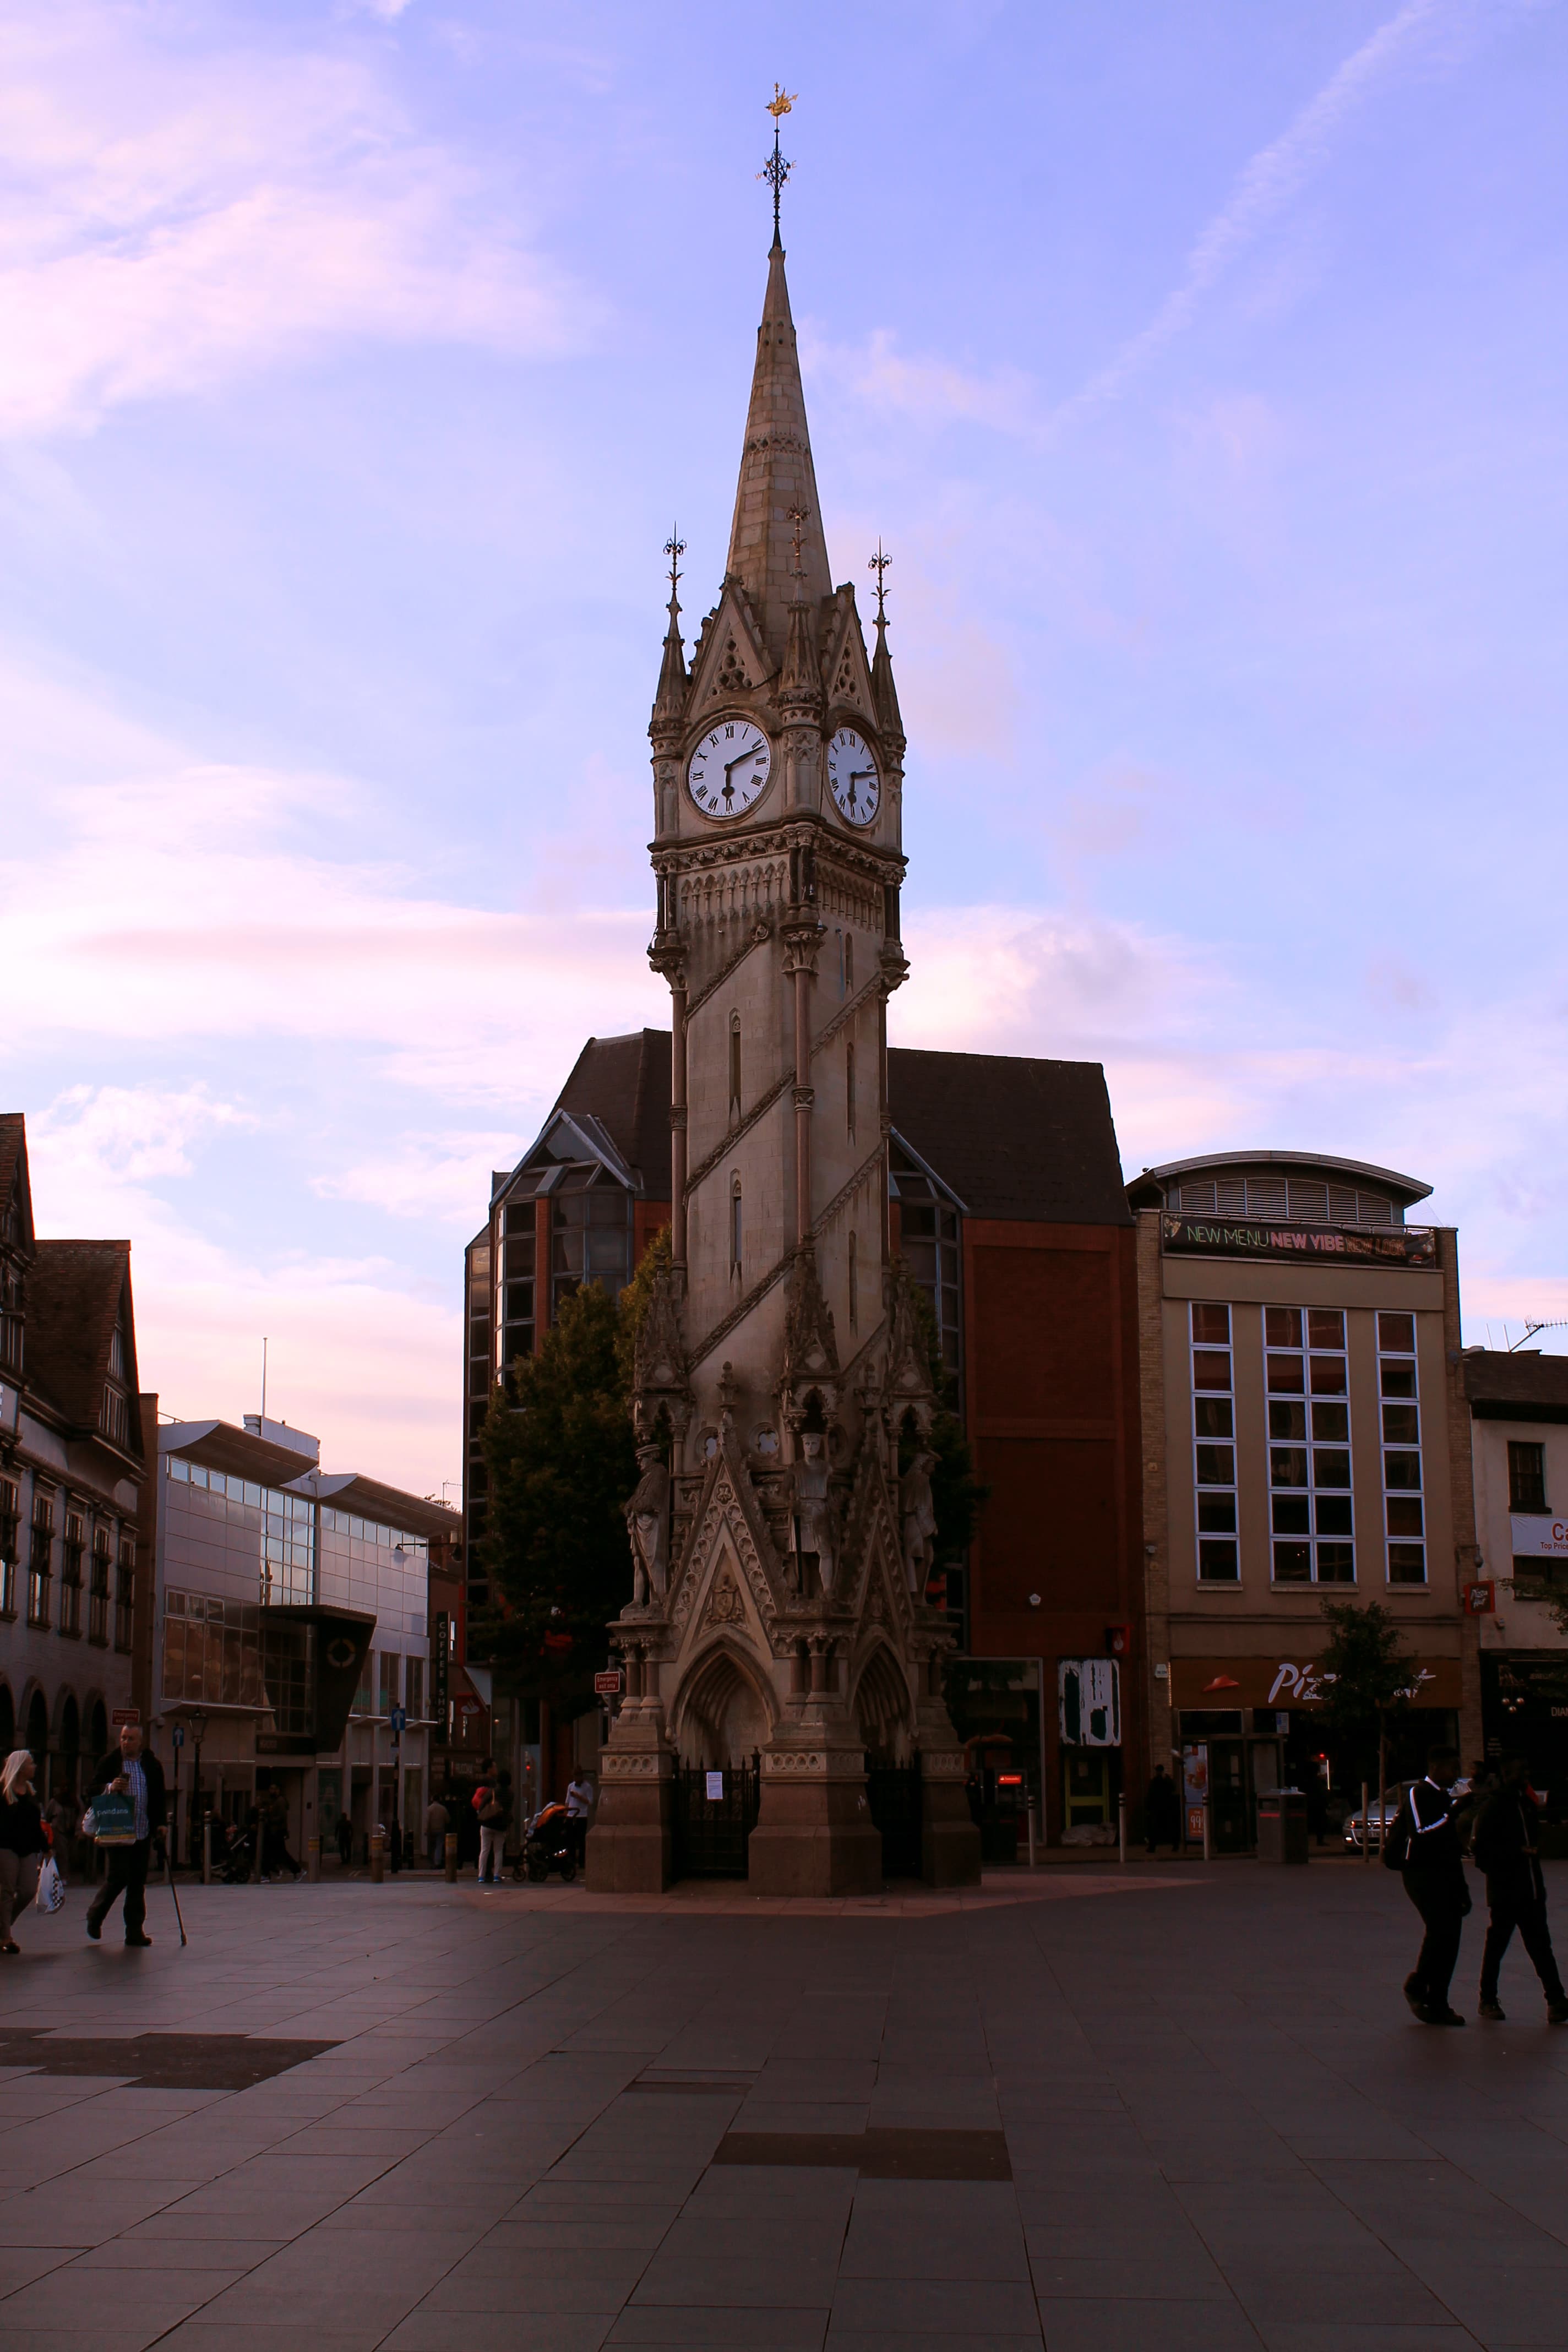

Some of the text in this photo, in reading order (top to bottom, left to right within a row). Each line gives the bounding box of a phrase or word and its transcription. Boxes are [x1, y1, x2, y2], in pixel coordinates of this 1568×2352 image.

[725, 726, 734, 739] XII
[709, 734, 719, 748] XI
[697, 752, 707, 761] X
[755, 757, 766, 765] III
[693, 771, 704, 781] IX
[742, 791, 750, 803] V
[707, 796, 718, 811] VII
[1187, 1226, 1406, 1256] NEW MENU NEW VIBE NEW LOOK
[1540, 1542, 1552, 1550] Top
